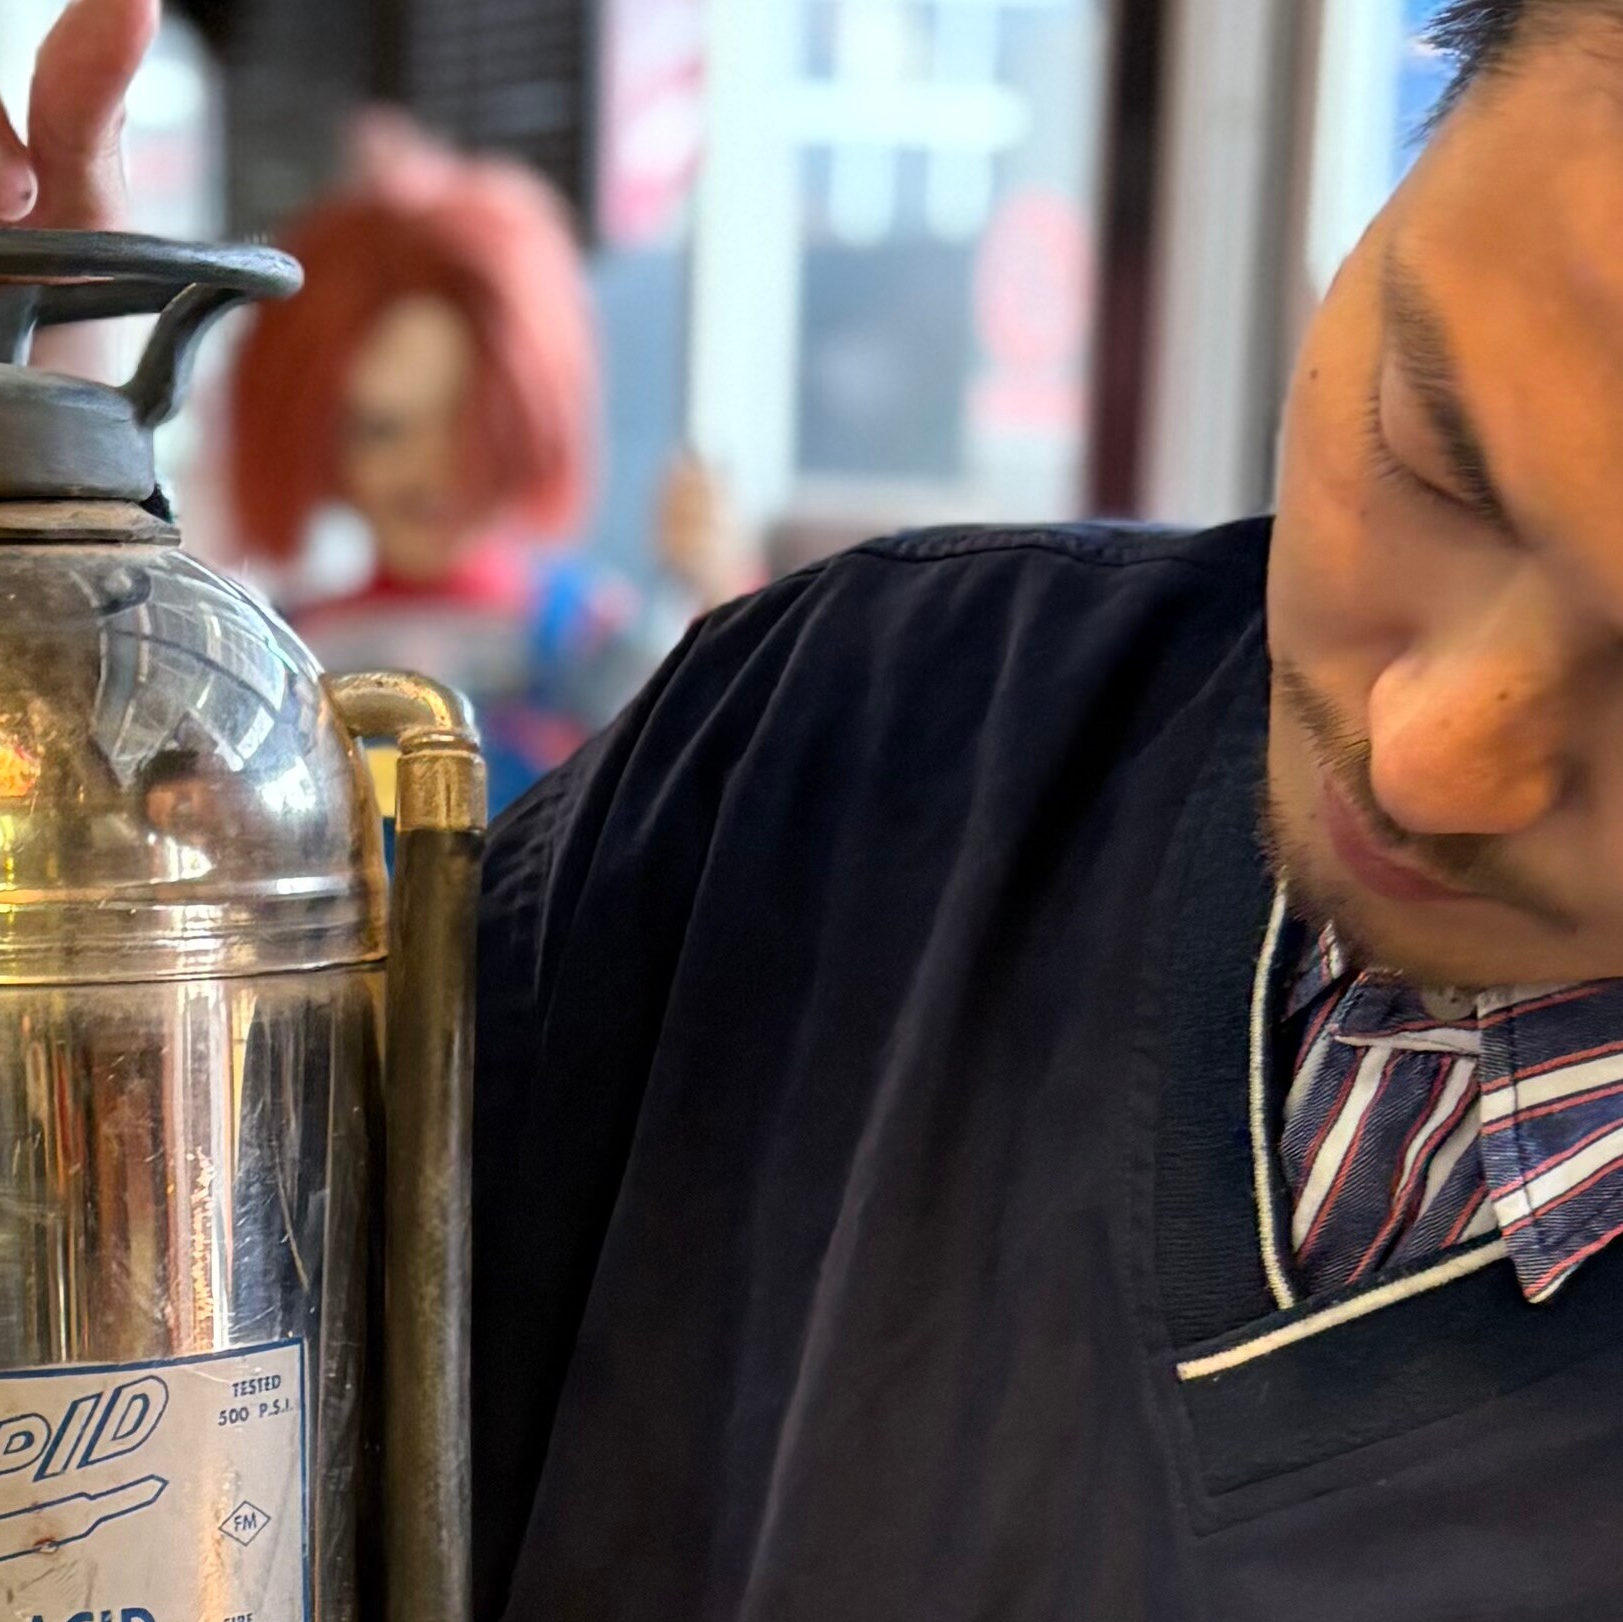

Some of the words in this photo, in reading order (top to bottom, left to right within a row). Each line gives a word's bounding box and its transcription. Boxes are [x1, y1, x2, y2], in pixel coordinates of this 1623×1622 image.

[232, 1374, 281, 1398] TESTED
[218, 1407, 249, 1427] 500
[234, 1512, 258, 1532] FM
